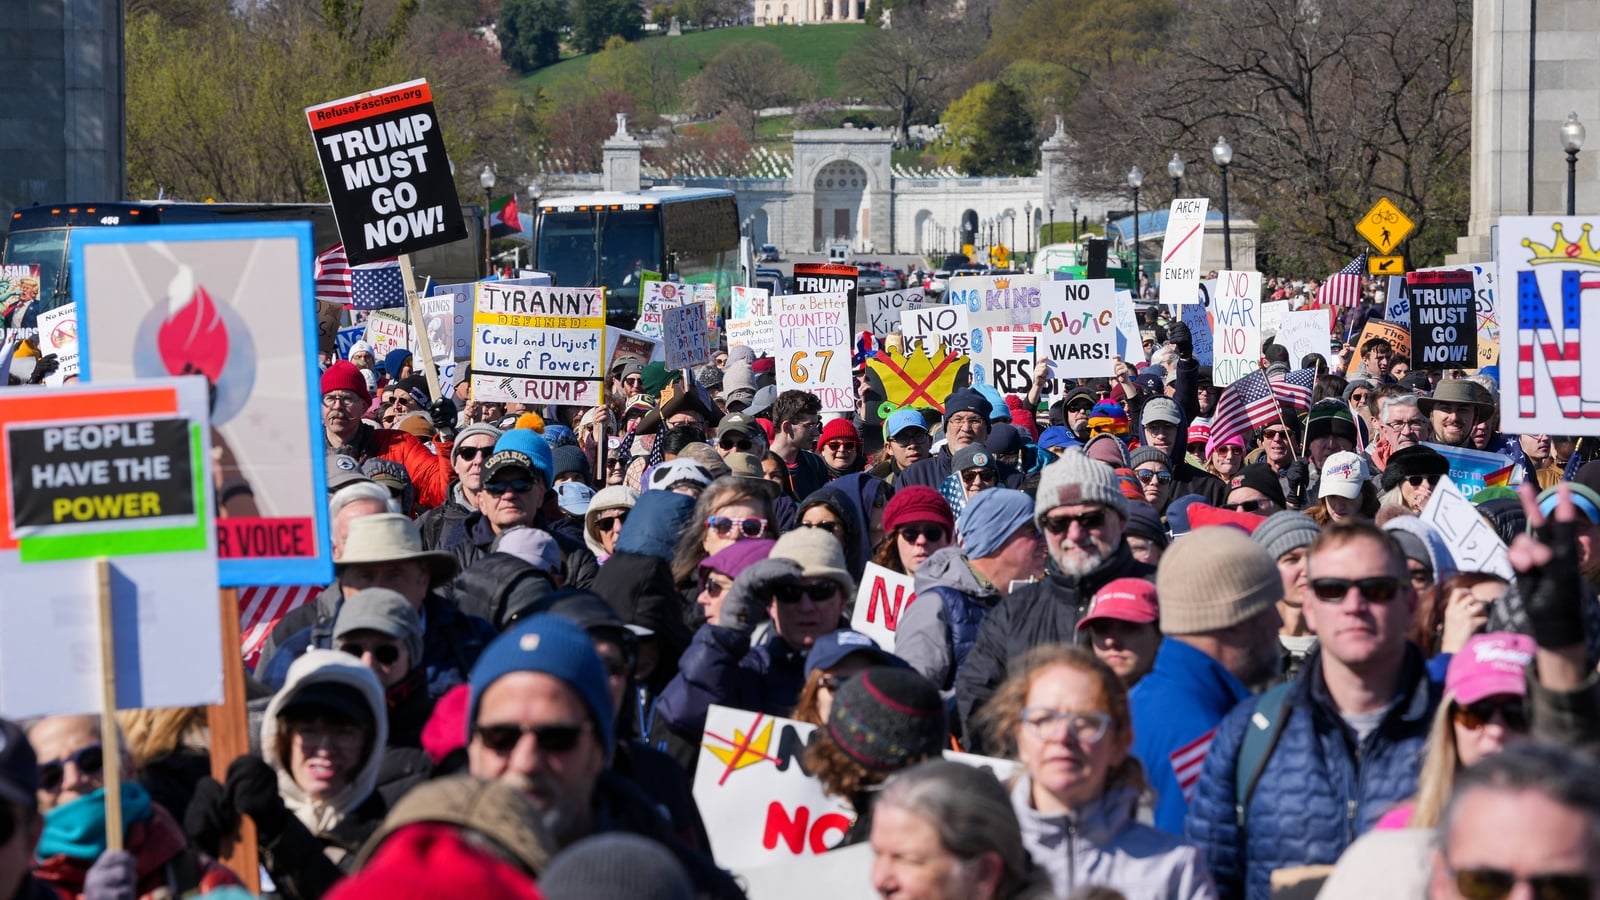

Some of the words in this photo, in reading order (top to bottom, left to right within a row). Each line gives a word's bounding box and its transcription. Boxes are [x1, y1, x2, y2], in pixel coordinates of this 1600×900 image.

[317, 89, 422, 121] RefuseFascism.org
[322, 113, 433, 162] TRUMP
[341, 145, 429, 191] MUST
[371, 181, 418, 215] GO
[1175, 201, 1201, 213] ARCH
[363, 205, 446, 251] NOW!
[1165, 268, 1195, 280] ENEMY
[796, 277, 855, 293] TRUMP
[1065, 284, 1090, 302] NO
[1225, 272, 1249, 298] NO
[428, 299, 451, 313] KINGS
[484, 288, 596, 315] TYRANNY
[781, 298, 797, 311] For
[800, 303, 806, 311] a
[810, 295, 847, 310] Better
[878, 293, 904, 310] NO
[952, 289, 982, 313] NO
[985, 286, 1042, 312] KING
[1412, 288, 1472, 306] TRUMP
[45, 313, 57, 322] No
[58, 306, 77, 318] Kin
[644, 302, 659, 313] ONE
[644, 312, 661, 323] DEST
[1214, 298, 1256, 328] WAR
[1389, 300, 1410, 319] ICE
[1419, 307, 1468, 325] MUST
[498, 315, 589, 329] DEFINED:
[754, 318, 773, 327] chao
[779, 312, 841, 328] COUNTRY
[917, 309, 958, 336] NO
[1043, 309, 1113, 336] IDIOTIC
[482, 329, 518, 345] Cruel
[523, 332, 546, 347] and
[551, 332, 597, 353] Unjust
[780, 327, 800, 348] WE
[807, 326, 844, 348] NEED
[1223, 328, 1246, 355] NO
[1384, 327, 1405, 341] The
[1431, 326, 1458, 344] GO
[1049, 343, 1110, 361] WARS!
[1423, 345, 1469, 363] NOW!
[1517, 270, 1600, 419] N
[60, 352, 80, 364] Sinc
[484, 351, 510, 368] Use
[516, 350, 532, 370] of
[539, 352, 595, 378] Power;
[43, 421, 155, 453] PEOPLE
[484, 450, 511, 469] COSTA
[511, 450, 531, 468] RICA
[32, 460, 112, 489] HAVE
[113, 456, 171, 482] THE
[53, 492, 162, 523] POWER
[236, 523, 306, 556] VOICE
[866, 575, 917, 632] N
[776, 724, 817, 778] N
